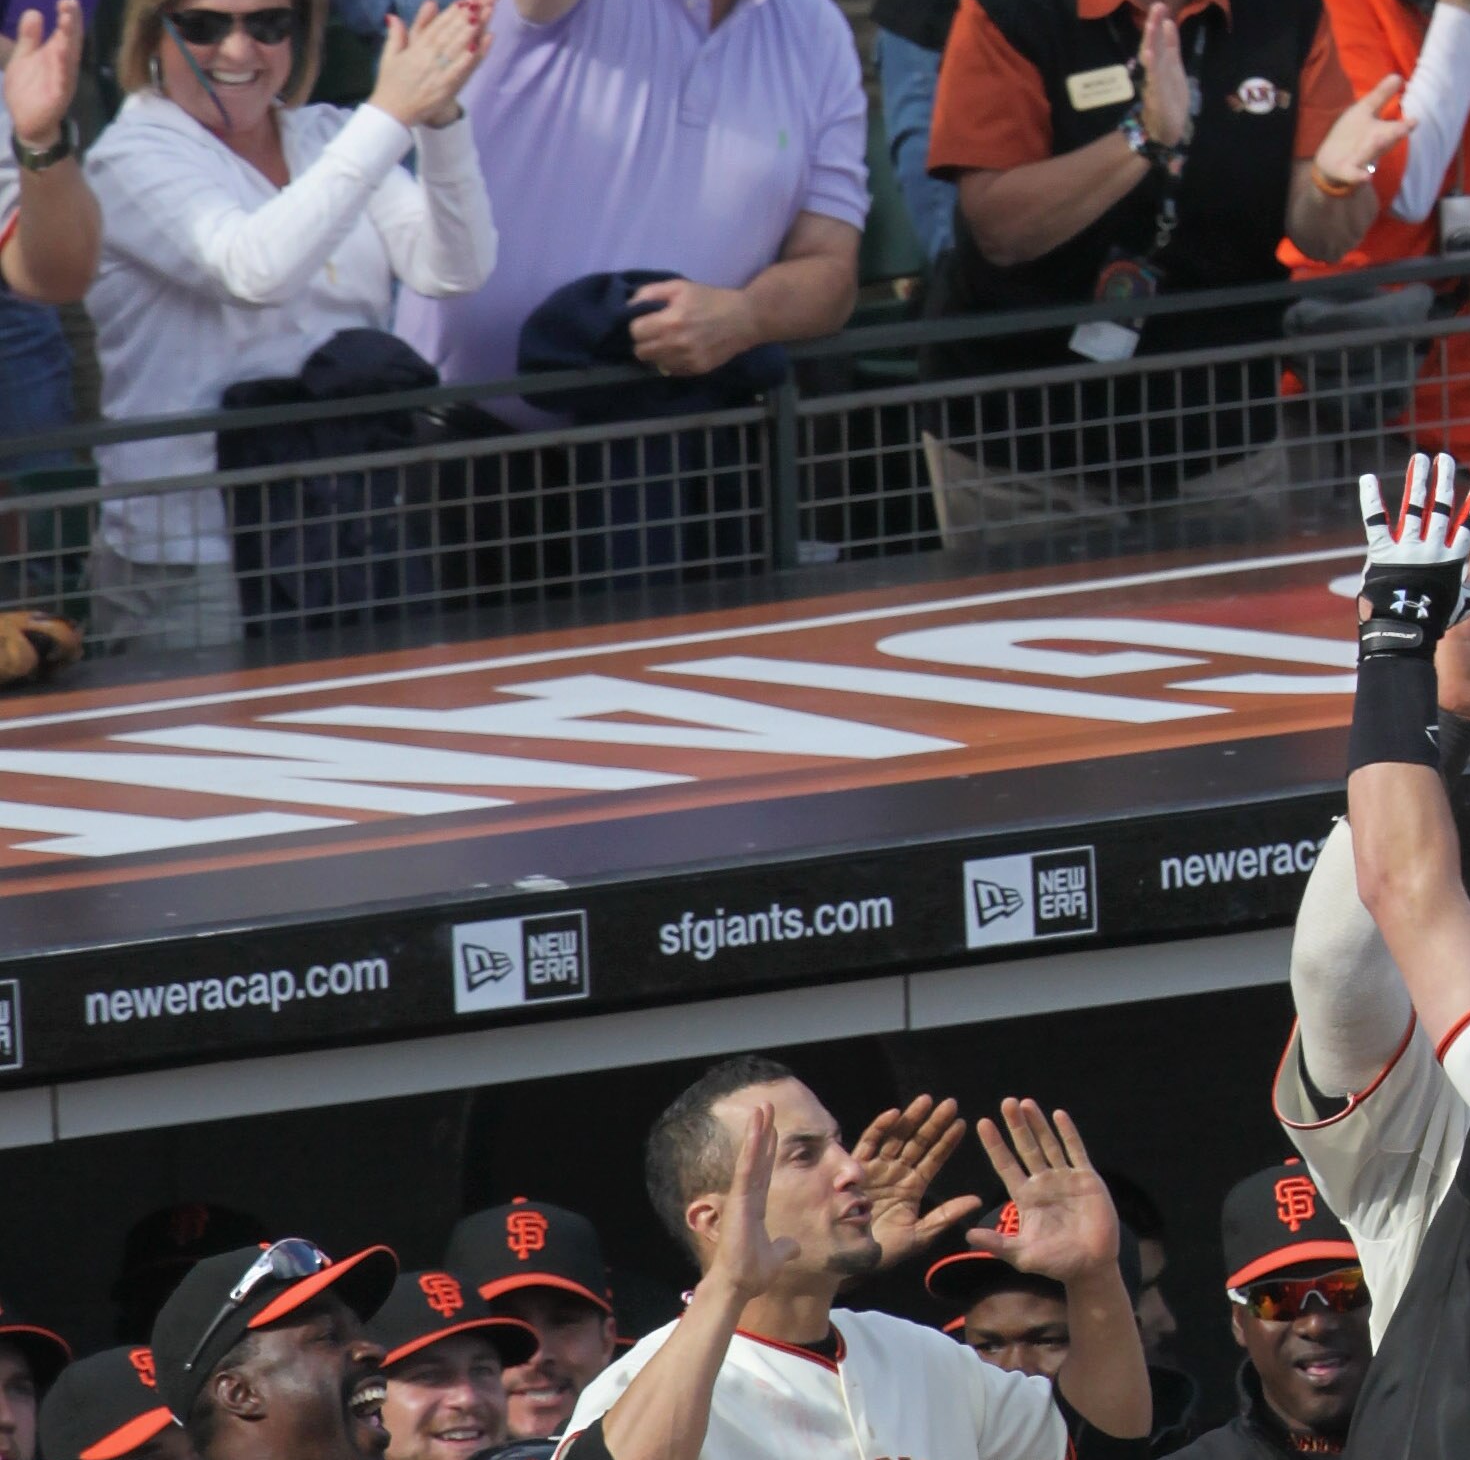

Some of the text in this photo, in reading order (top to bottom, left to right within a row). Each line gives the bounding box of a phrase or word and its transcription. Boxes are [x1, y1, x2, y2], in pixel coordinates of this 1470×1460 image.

[1038, 866, 1086, 896] NEW
[1160, 838, 1326, 889] newerac
[660, 896, 894, 961] sfgiants.com
[1039, 895, 1087, 920] ERA
[529, 930, 577, 958] NEW
[85, 957, 389, 1025] neweracap.com
[529, 958, 578, 985] ERA
[1273, 1174, 1318, 1233] SF
[506, 1211, 549, 1261] SF
